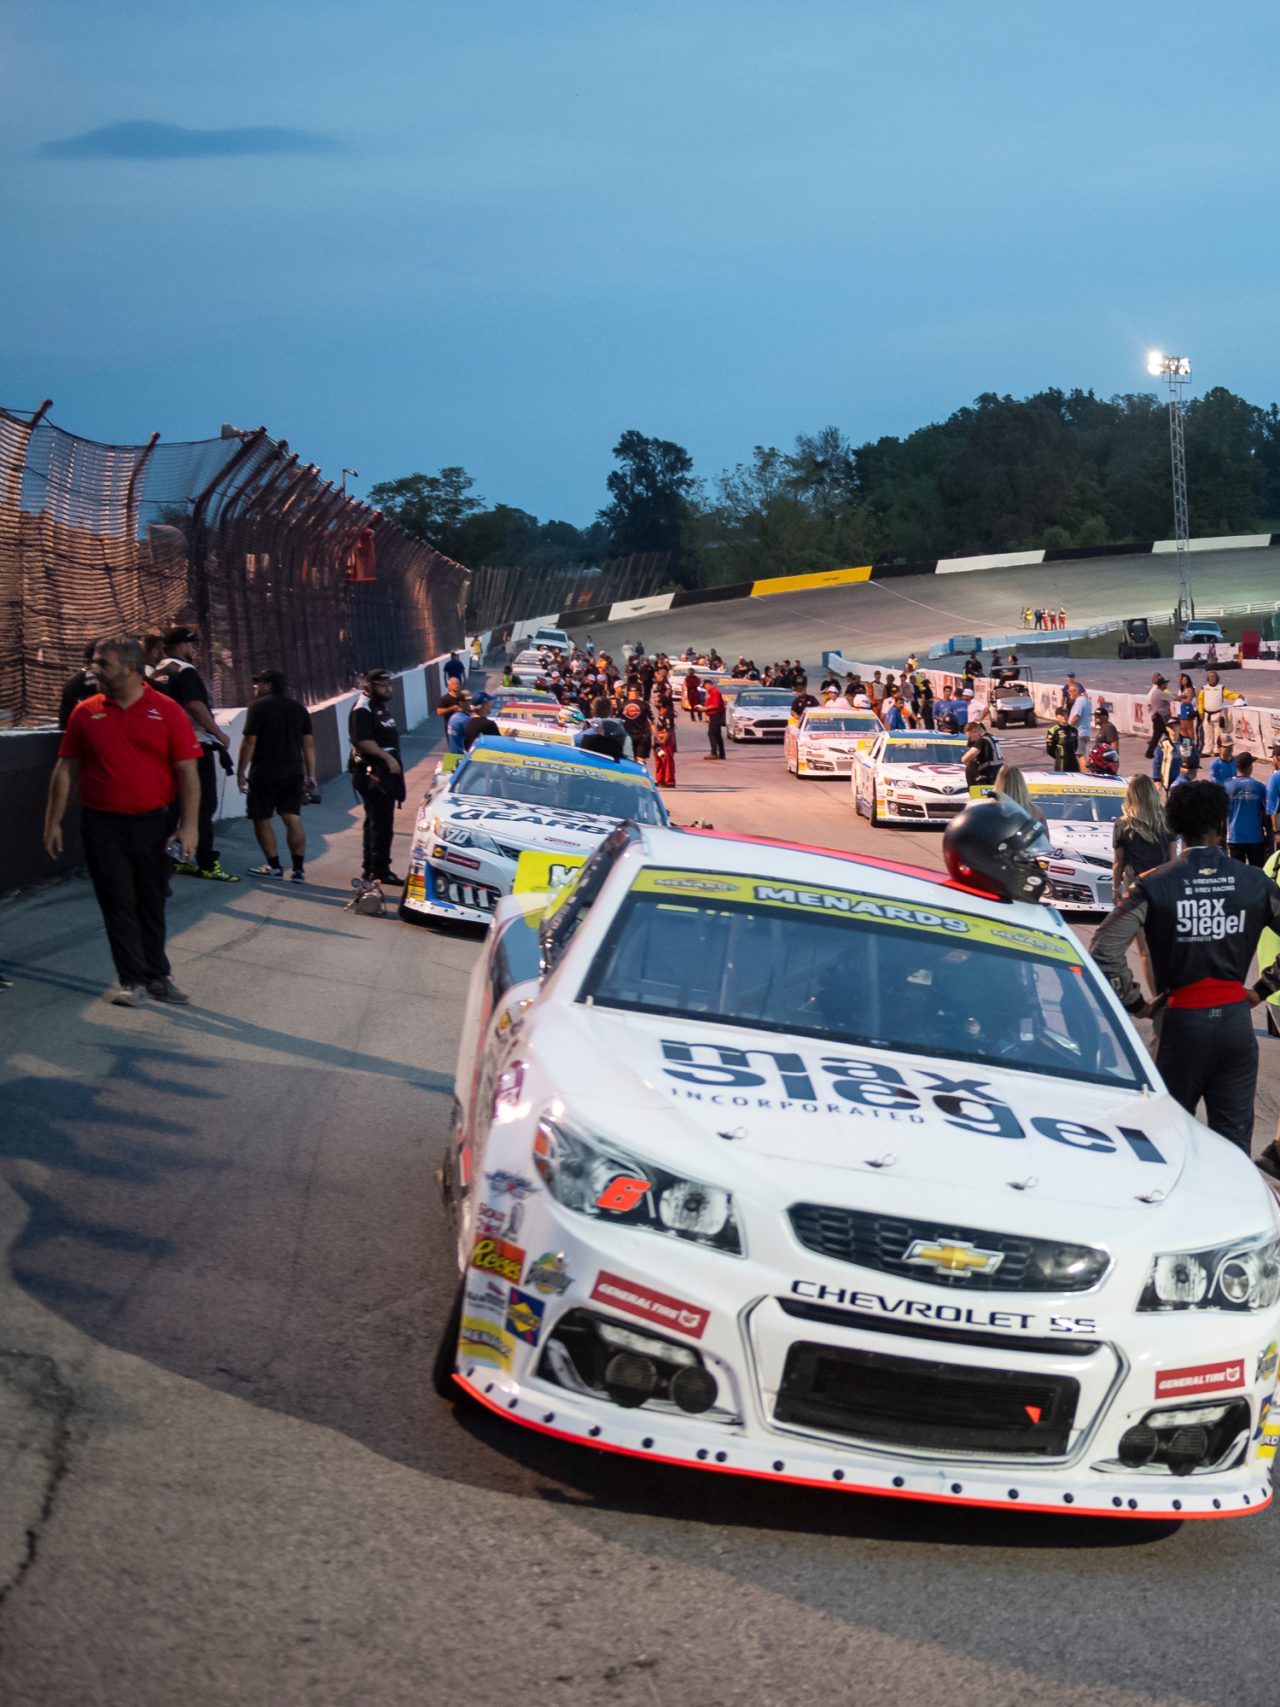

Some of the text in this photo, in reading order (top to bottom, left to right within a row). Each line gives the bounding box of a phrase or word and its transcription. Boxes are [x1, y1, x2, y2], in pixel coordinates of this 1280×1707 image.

[654, 878, 739, 893] MENARDS
[753, 884, 971, 933] MENARDS
[1176, 898, 1226, 919] max
[660, 1039, 1005, 1105] max
[670, 1086, 926, 1125] INCORPORATED
[595, 1176, 652, 1212] 6
[597, 1282, 681, 1320] GENERAL TIRE
[790, 1280, 1096, 1334] CHEVROLET SS
[1158, 1371, 1226, 1390] GENERAL TIRE
